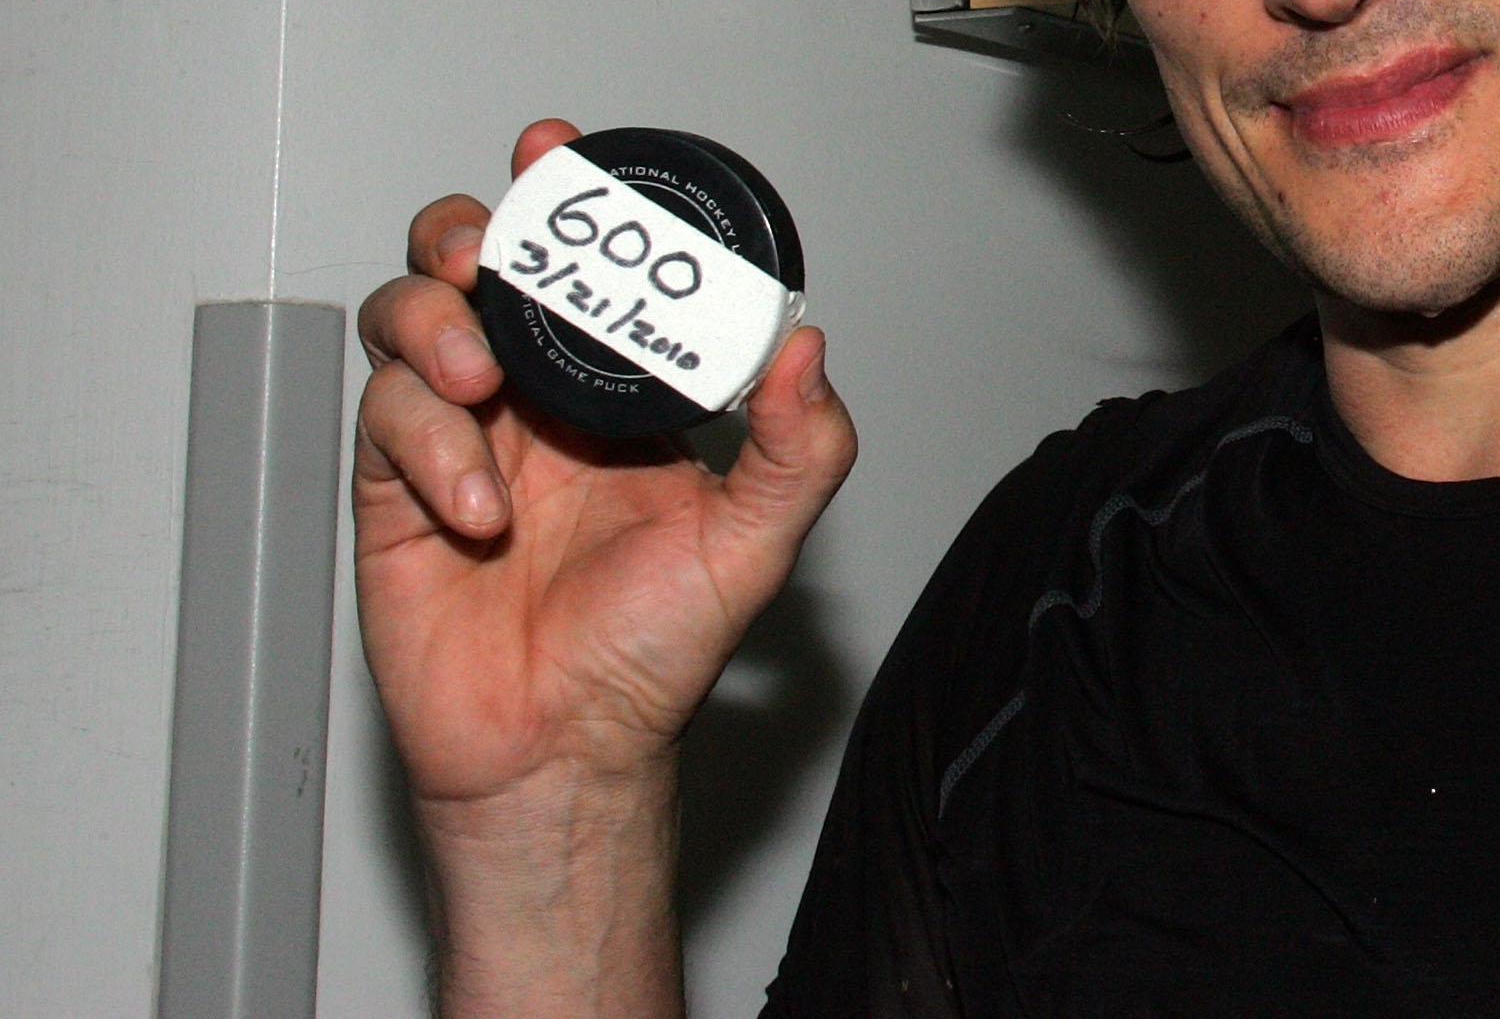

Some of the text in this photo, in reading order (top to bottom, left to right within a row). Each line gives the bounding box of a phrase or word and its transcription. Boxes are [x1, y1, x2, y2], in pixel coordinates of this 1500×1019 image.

[547, 187, 703, 300] 600
[610, 165, 680, 185] ATIONAL
[685, 182, 736, 237] HOCKEY
[510, 239, 700, 370] 3/21/2010
[547, 348, 588, 383] GAME
[593, 379, 639, 393] PUCK
